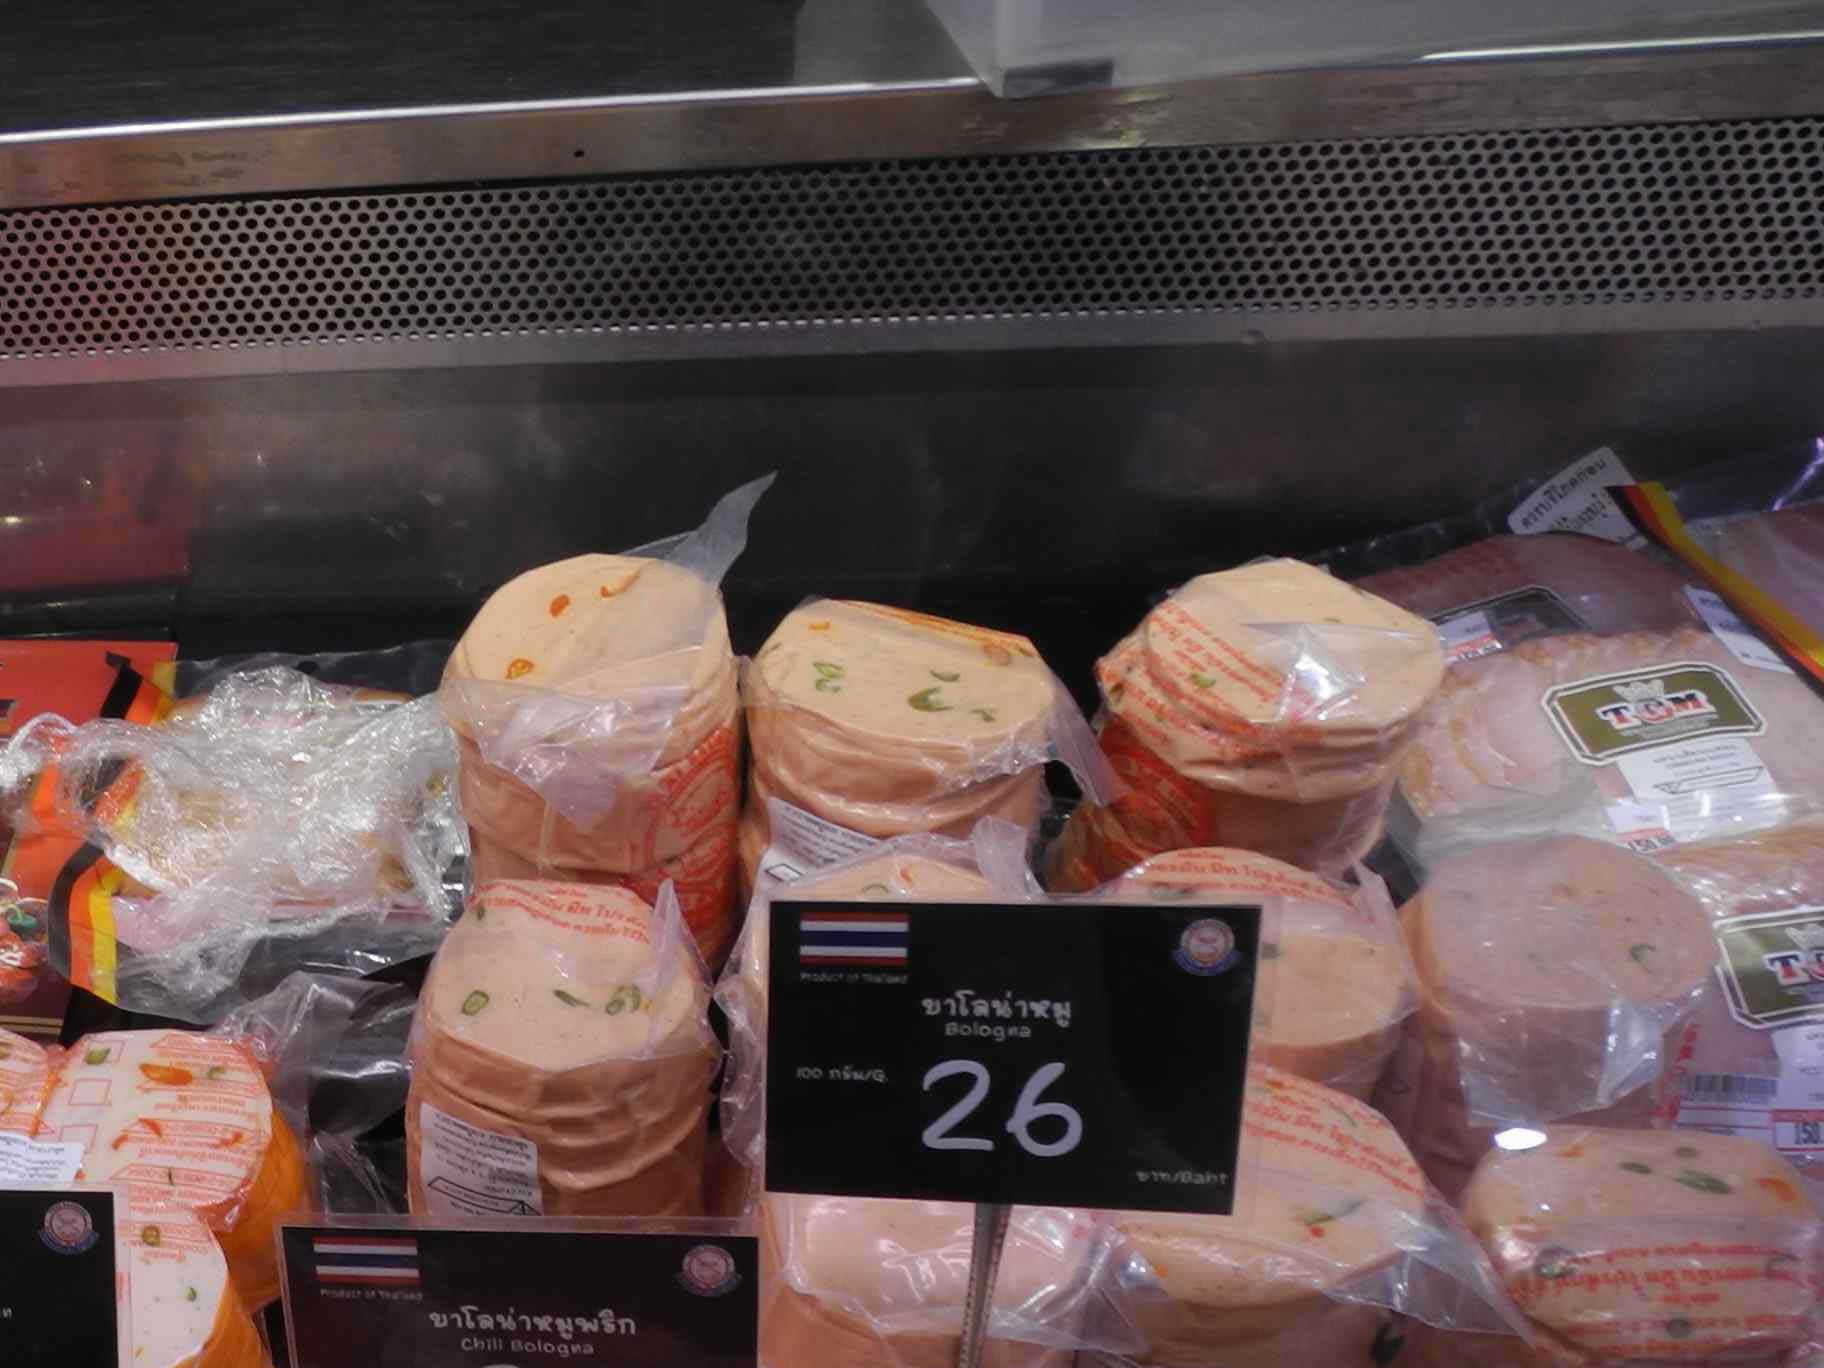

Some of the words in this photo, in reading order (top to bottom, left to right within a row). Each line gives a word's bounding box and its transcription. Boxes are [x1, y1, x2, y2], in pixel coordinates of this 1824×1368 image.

[1595, 691, 1711, 725] TGM
[945, 1022, 1032, 1042] Bologna
[922, 1059, 1083, 1157] 26
[461, 1337, 503, 1354] Chili
[511, 1339, 595, 1358] Bologna
